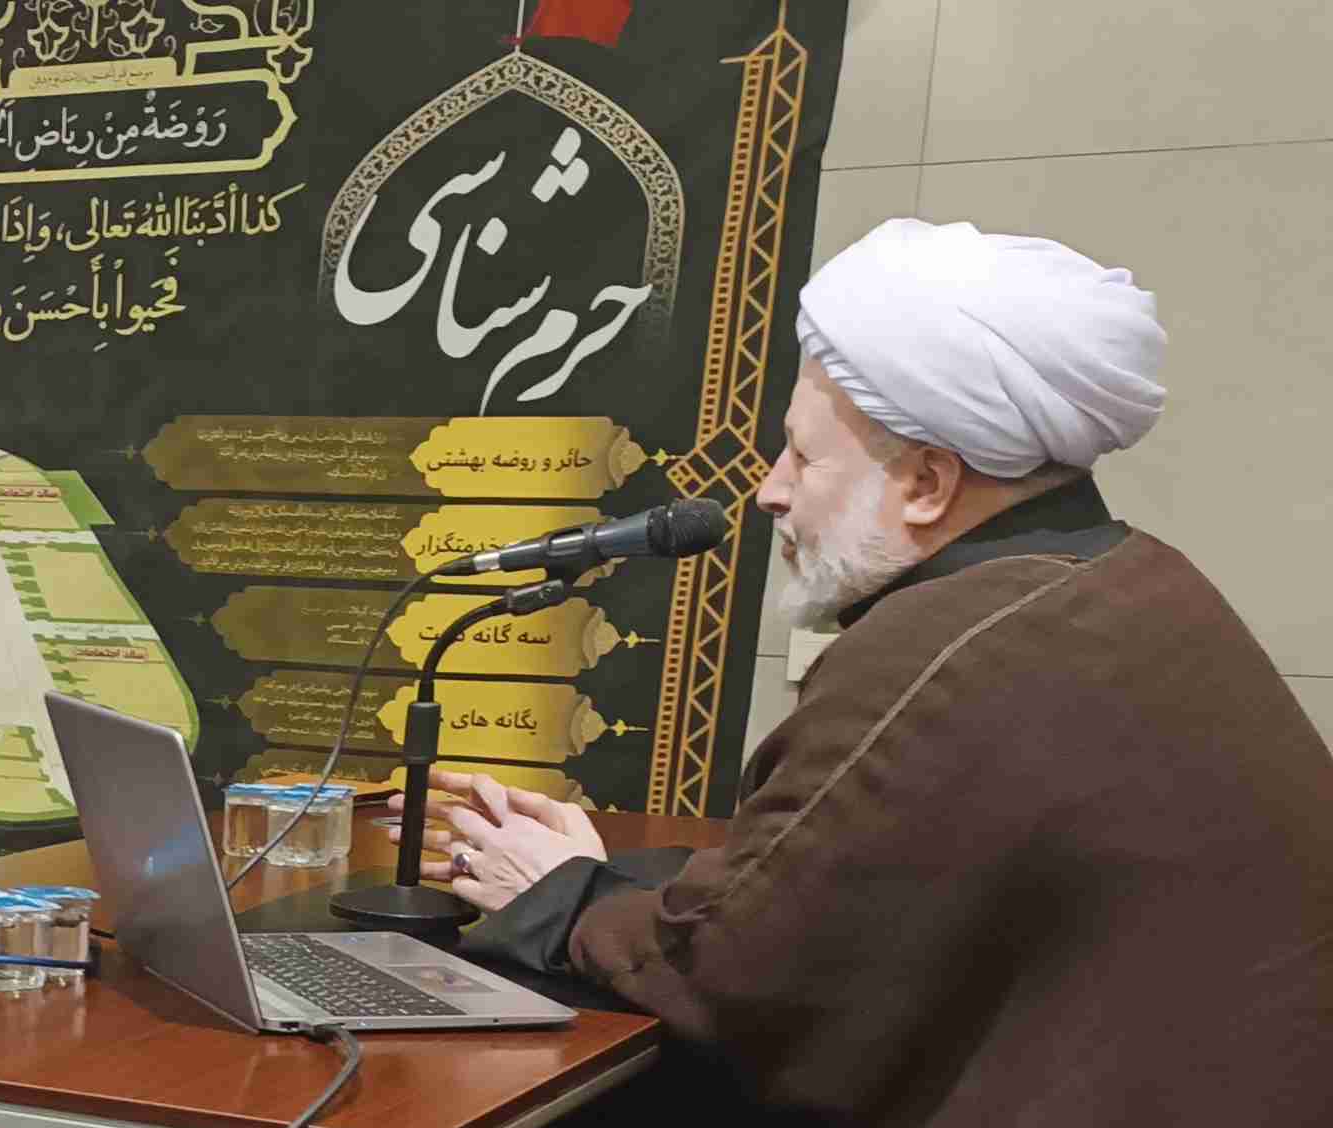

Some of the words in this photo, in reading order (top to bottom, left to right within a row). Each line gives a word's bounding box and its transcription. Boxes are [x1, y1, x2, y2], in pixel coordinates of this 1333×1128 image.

[426, 447, 487, 474] بهشتی
[491, 449, 537, 473] روضه
[541, 457, 551, 472] و
[472, 622, 513, 645] گانه
[516, 632, 552, 645] سه
